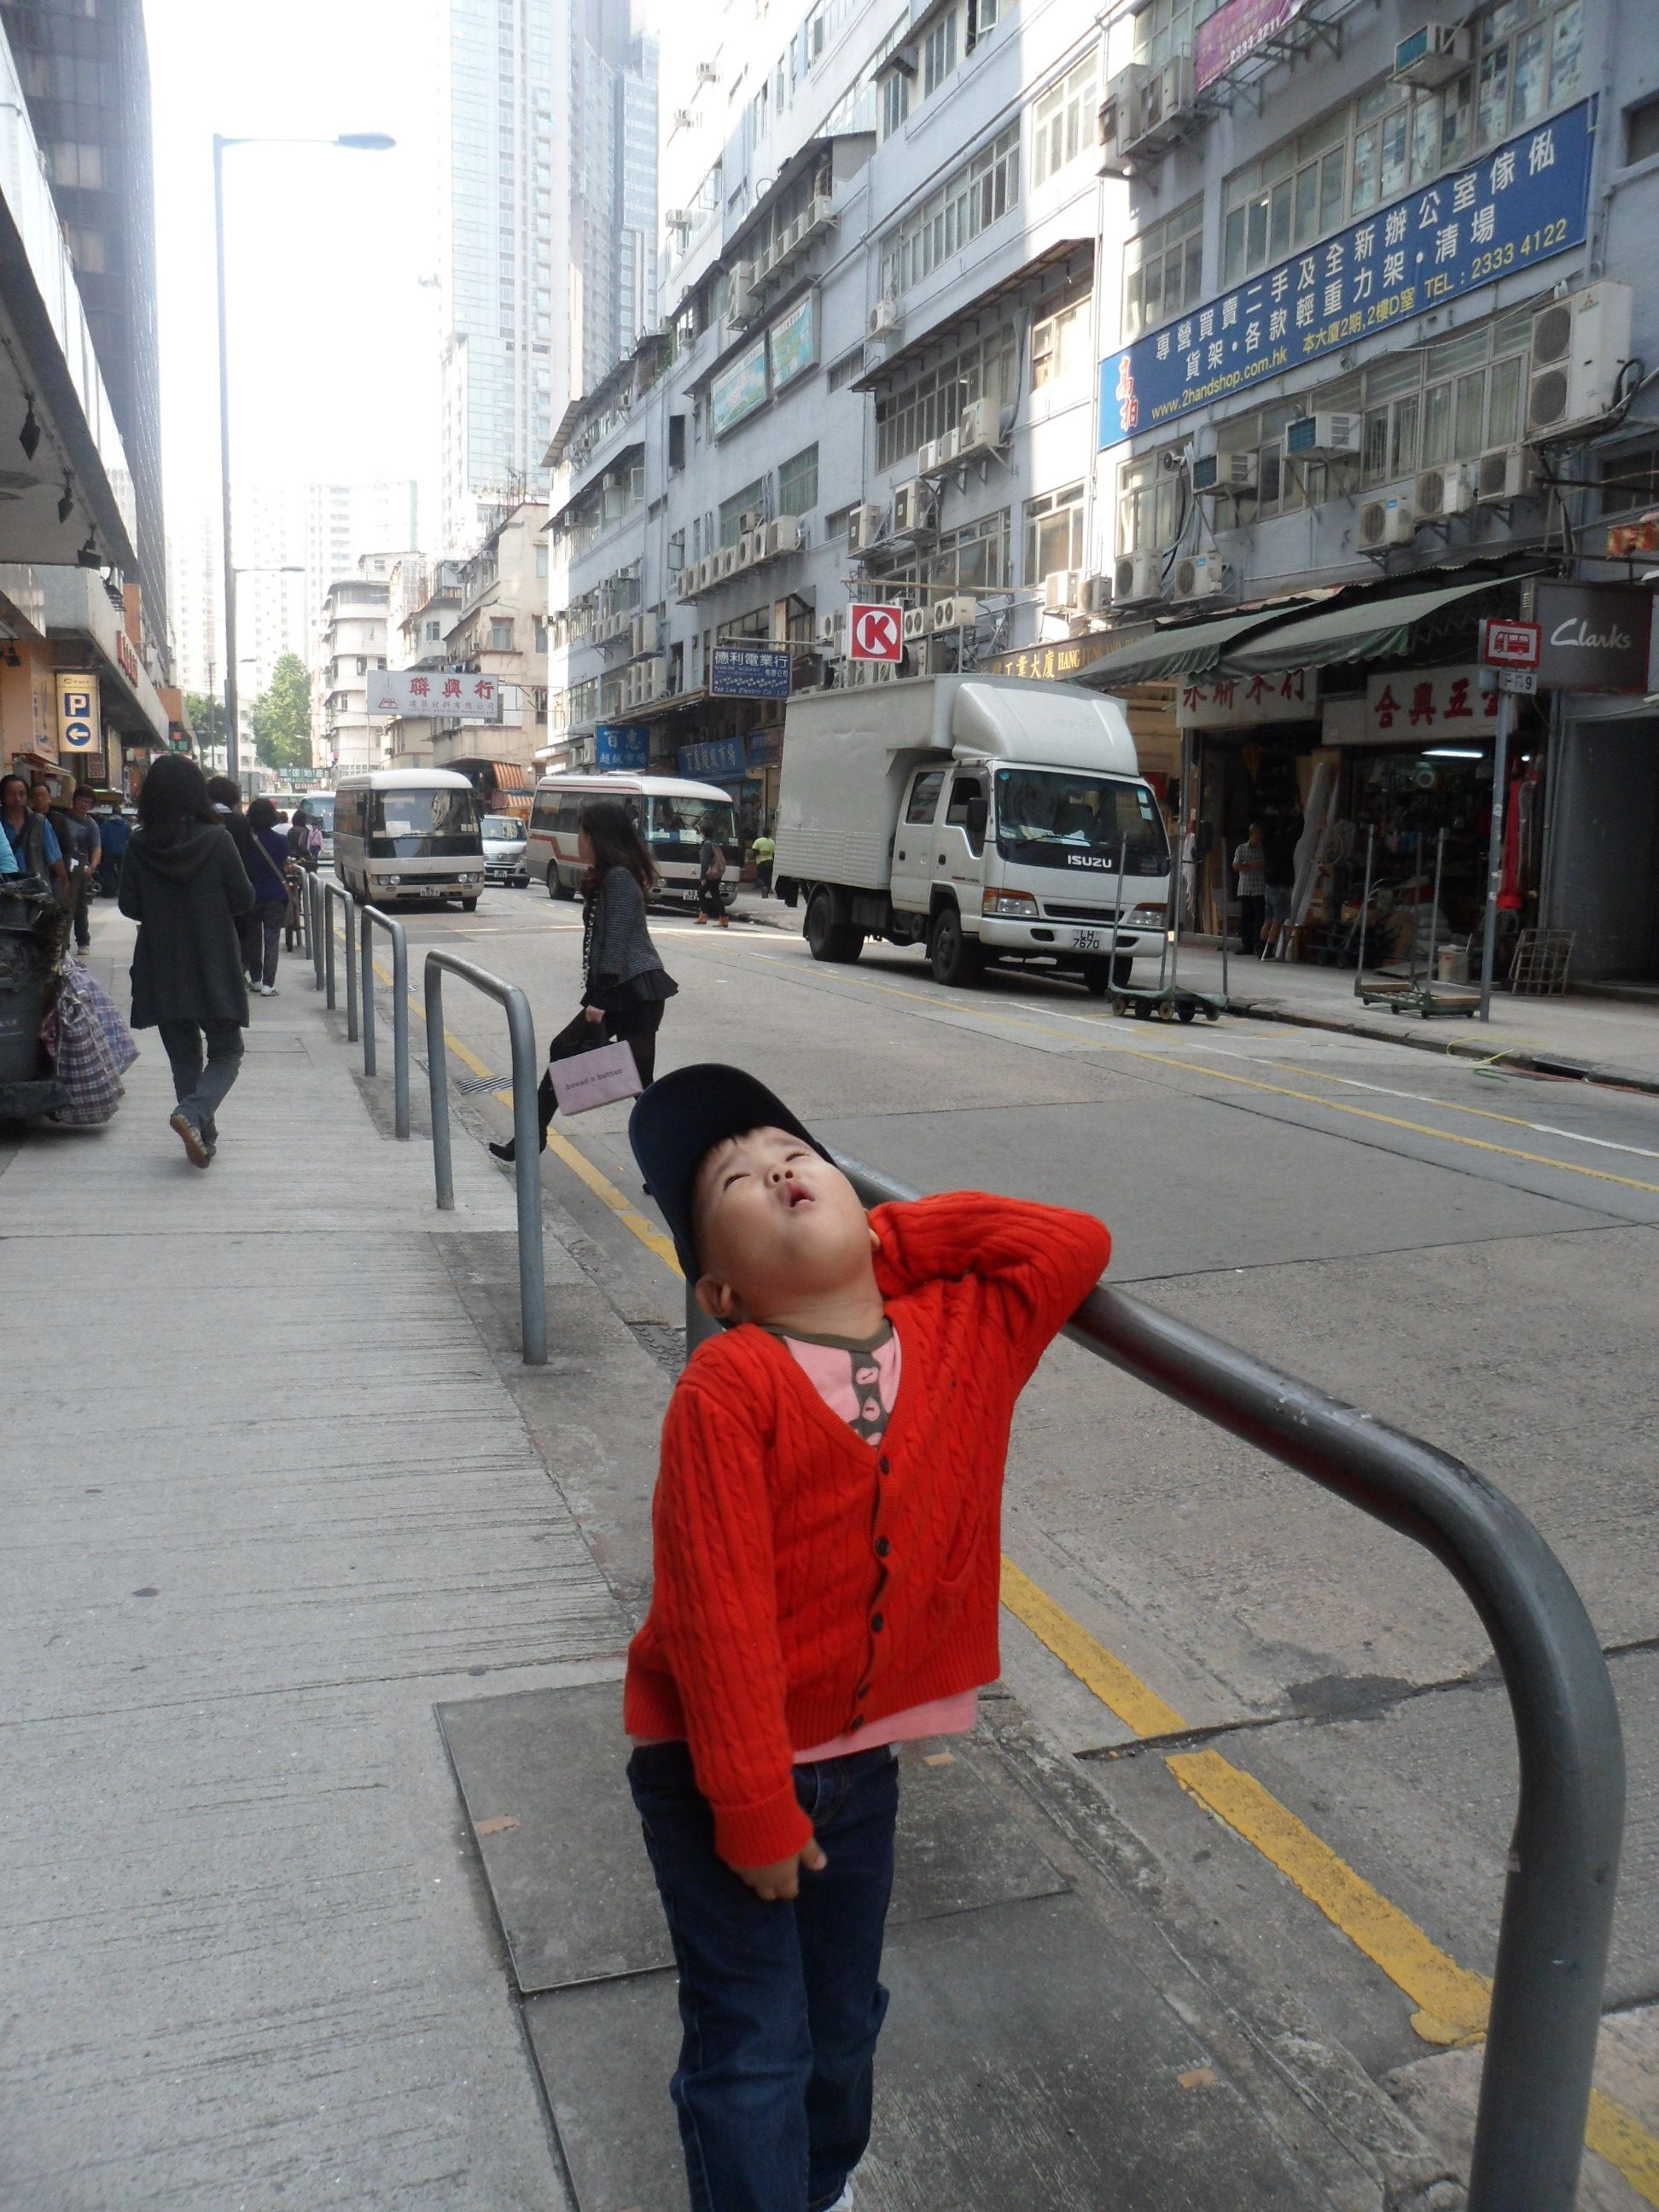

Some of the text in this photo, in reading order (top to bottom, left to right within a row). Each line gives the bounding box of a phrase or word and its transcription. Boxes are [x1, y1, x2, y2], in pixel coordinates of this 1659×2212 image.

[1470, 242, 1515, 280] 2333
[1520, 218, 1567, 255] 4122
[1152, 345, 1287, 420] www.2handshop.com.hk
[1550, 618, 1632, 649] Clarks
[714, 651, 789, 668] 德利電業行
[1057, 649, 1080, 671] HANG
[409, 676, 495, 701] 聯興行
[1525, 676, 1533, 690] 9
[68, 695, 87, 716] P
[1068, 854, 1112, 868] ISUZU
[1073, 938, 1100, 950] 7670
[1080, 929, 1094, 939] LH
